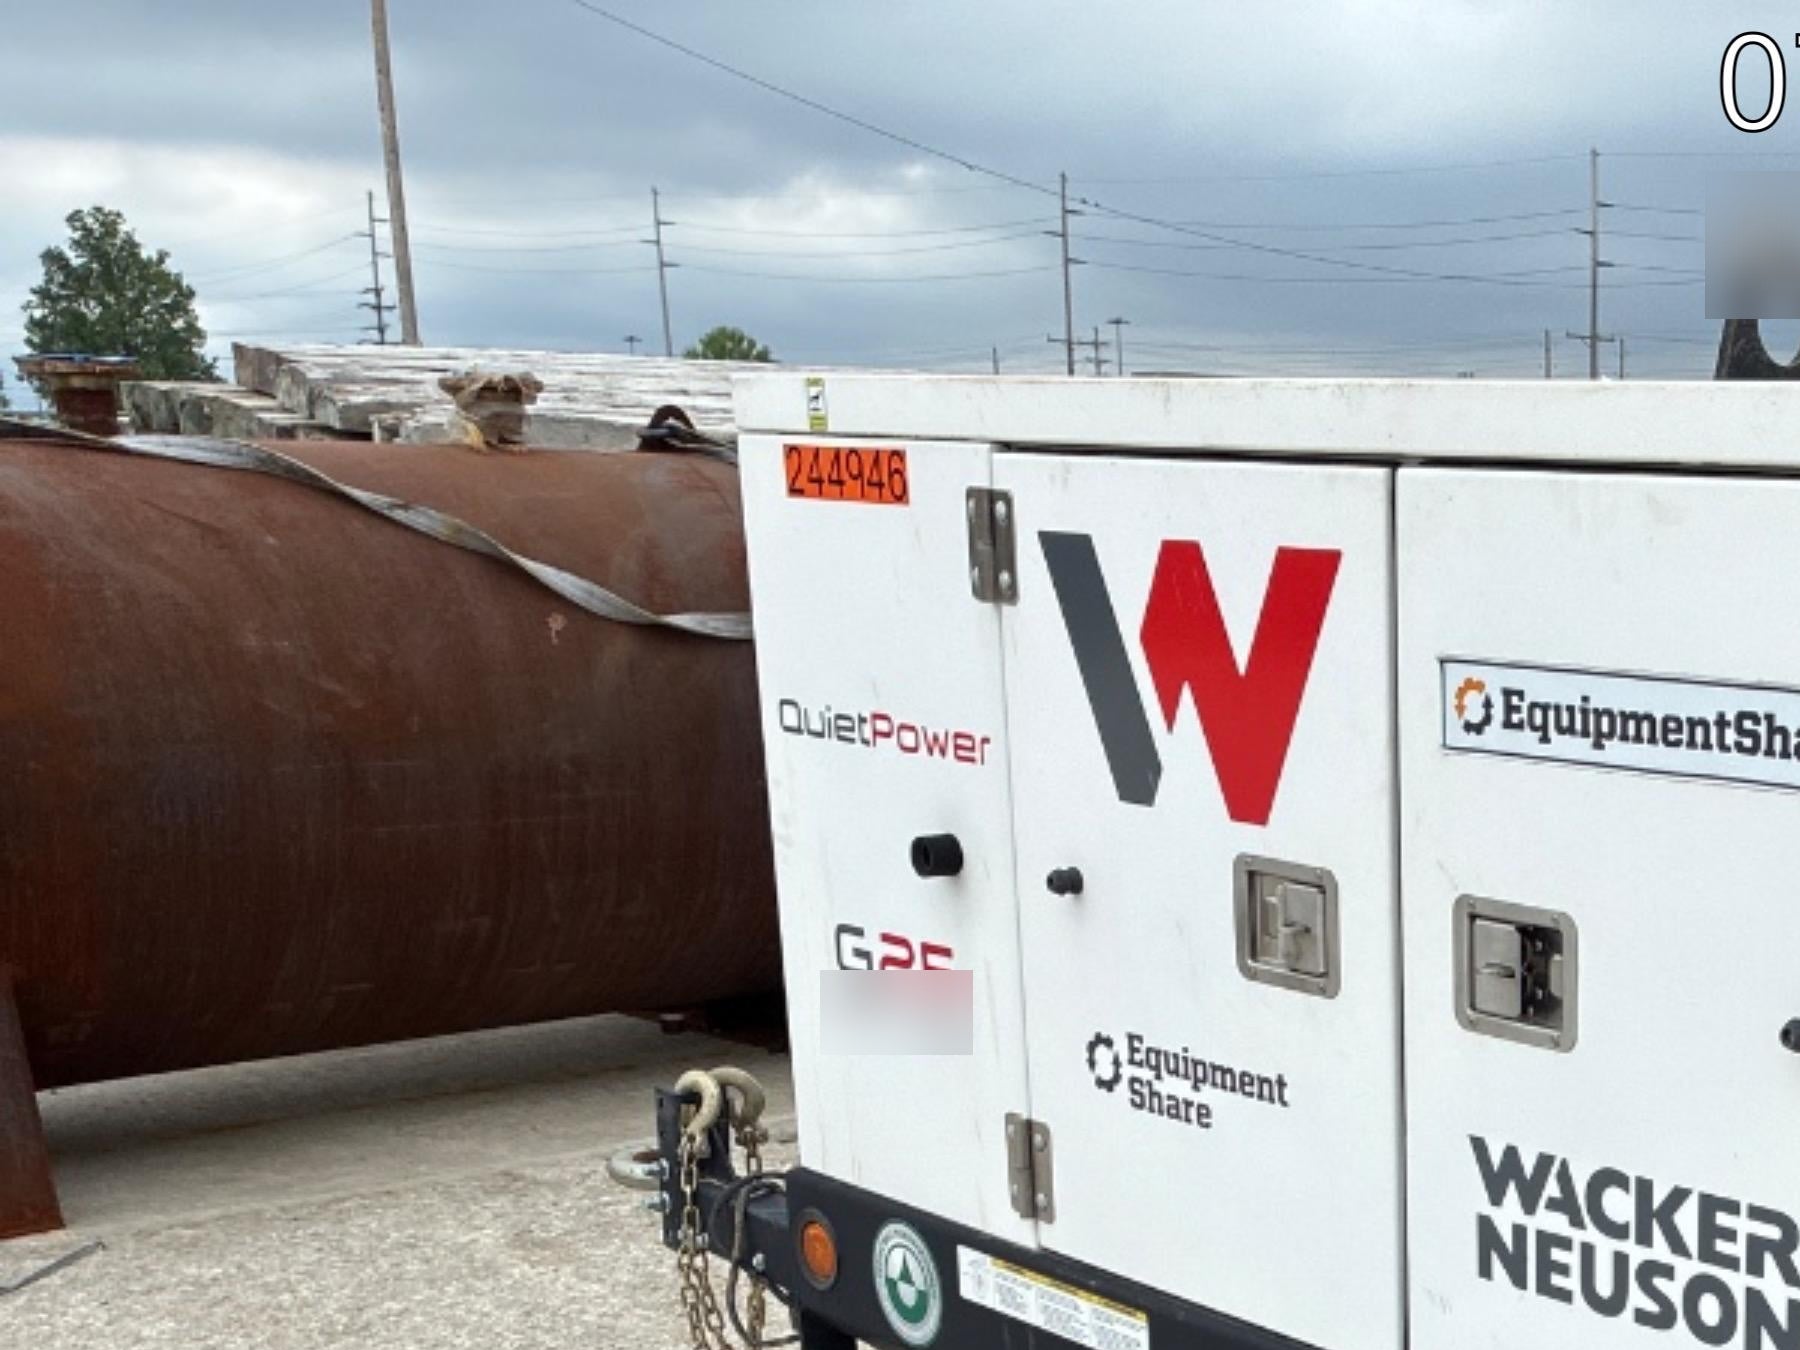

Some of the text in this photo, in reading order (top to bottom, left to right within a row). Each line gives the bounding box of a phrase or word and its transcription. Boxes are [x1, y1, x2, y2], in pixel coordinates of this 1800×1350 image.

[785, 446, 908, 502] 244946
[779, 698, 991, 765] QuietPower
[1125, 1031, 1289, 1108] Equipment
[1127, 1075, 1213, 1129] Share
